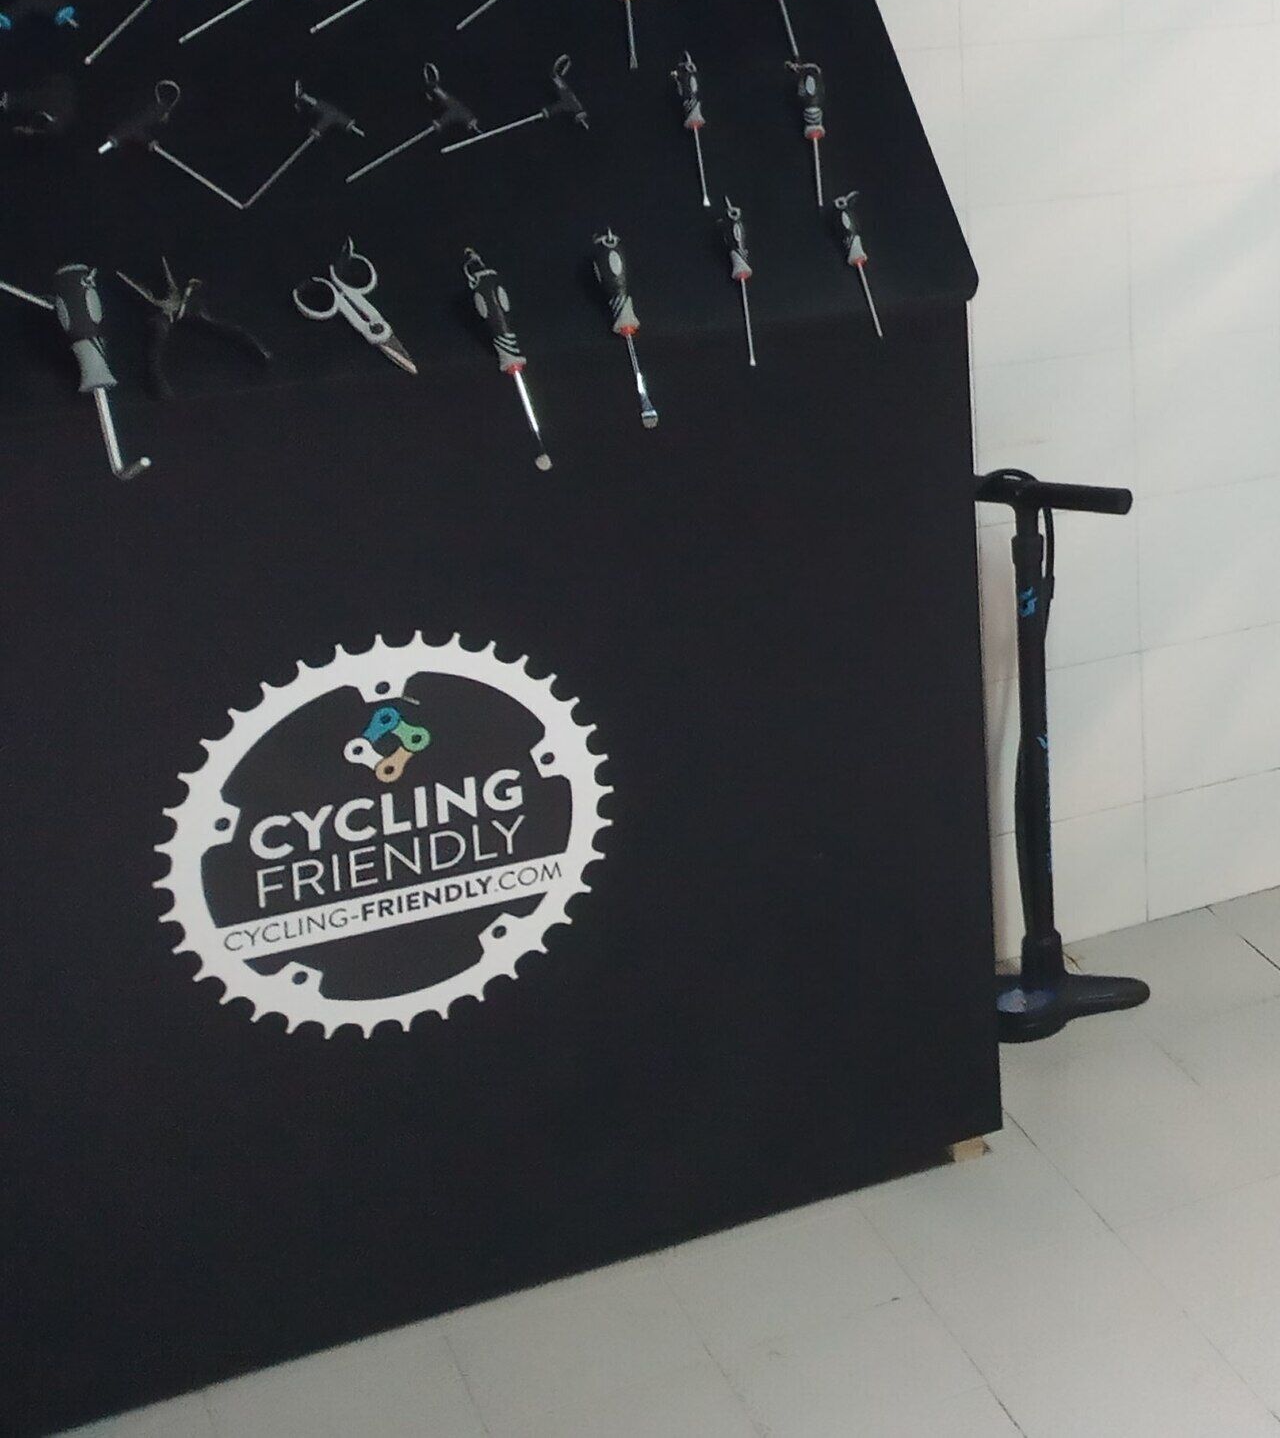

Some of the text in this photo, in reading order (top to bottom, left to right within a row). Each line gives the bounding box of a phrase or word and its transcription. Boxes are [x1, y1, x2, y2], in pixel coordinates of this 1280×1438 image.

[249, 768, 525, 861] CYCLING
[223, 861, 563, 953] CYCLING-FRIENDLY.COM
[256, 814, 526, 909] FRIENDLY
